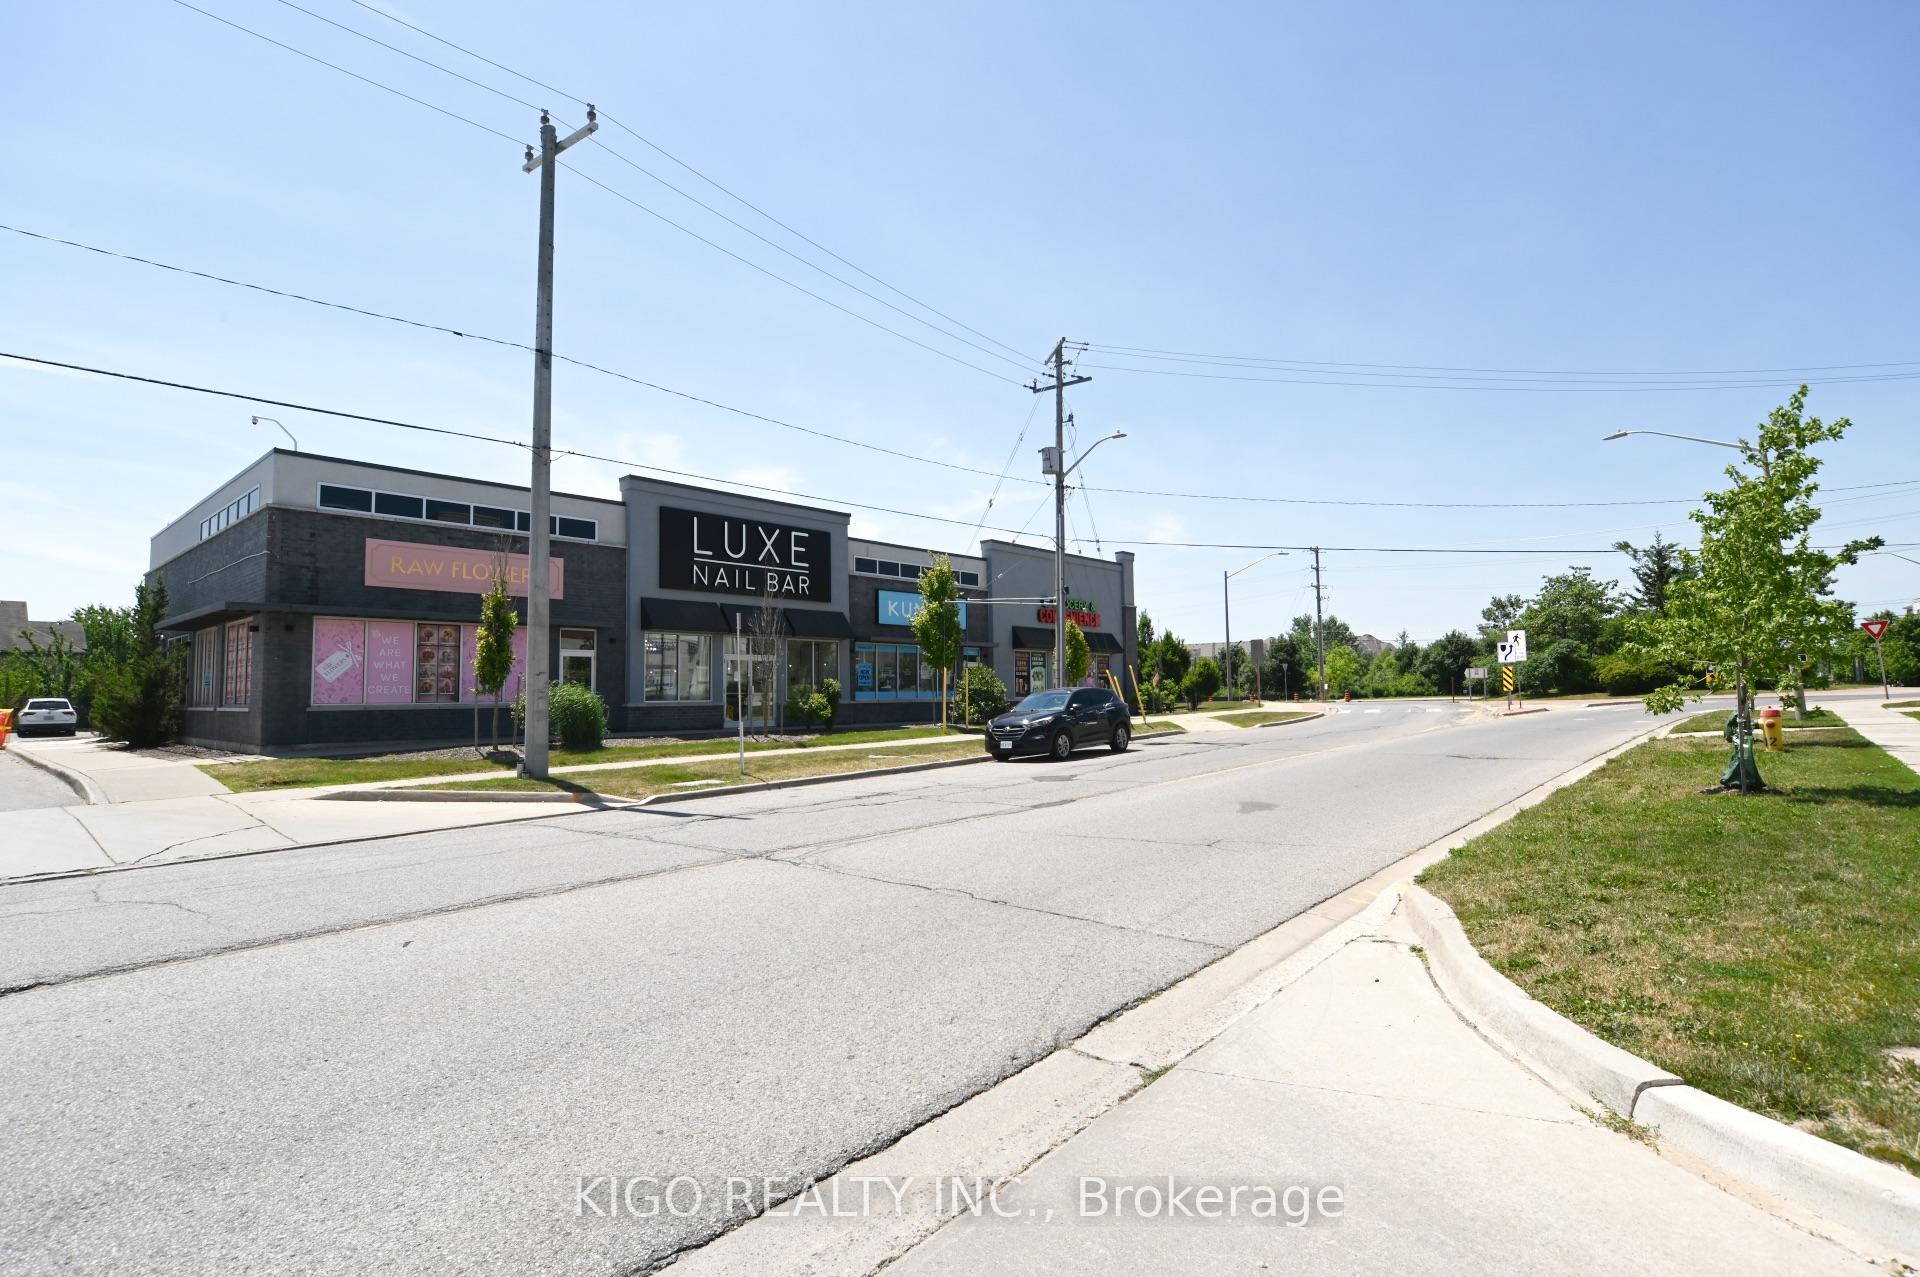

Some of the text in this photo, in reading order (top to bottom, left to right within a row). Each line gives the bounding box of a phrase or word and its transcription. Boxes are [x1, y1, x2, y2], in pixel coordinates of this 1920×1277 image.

[694, 516, 809, 567] LUXE
[391, 556, 529, 583] RAW FLOWER
[693, 565, 809, 595] NAIL BAR
[381, 636, 400, 645] WE
[379, 648, 401, 657] ARE
[374, 661, 407, 670] WHAT
[381, 673, 400, 682] WE
[368, 685, 410, 695] CREATE
